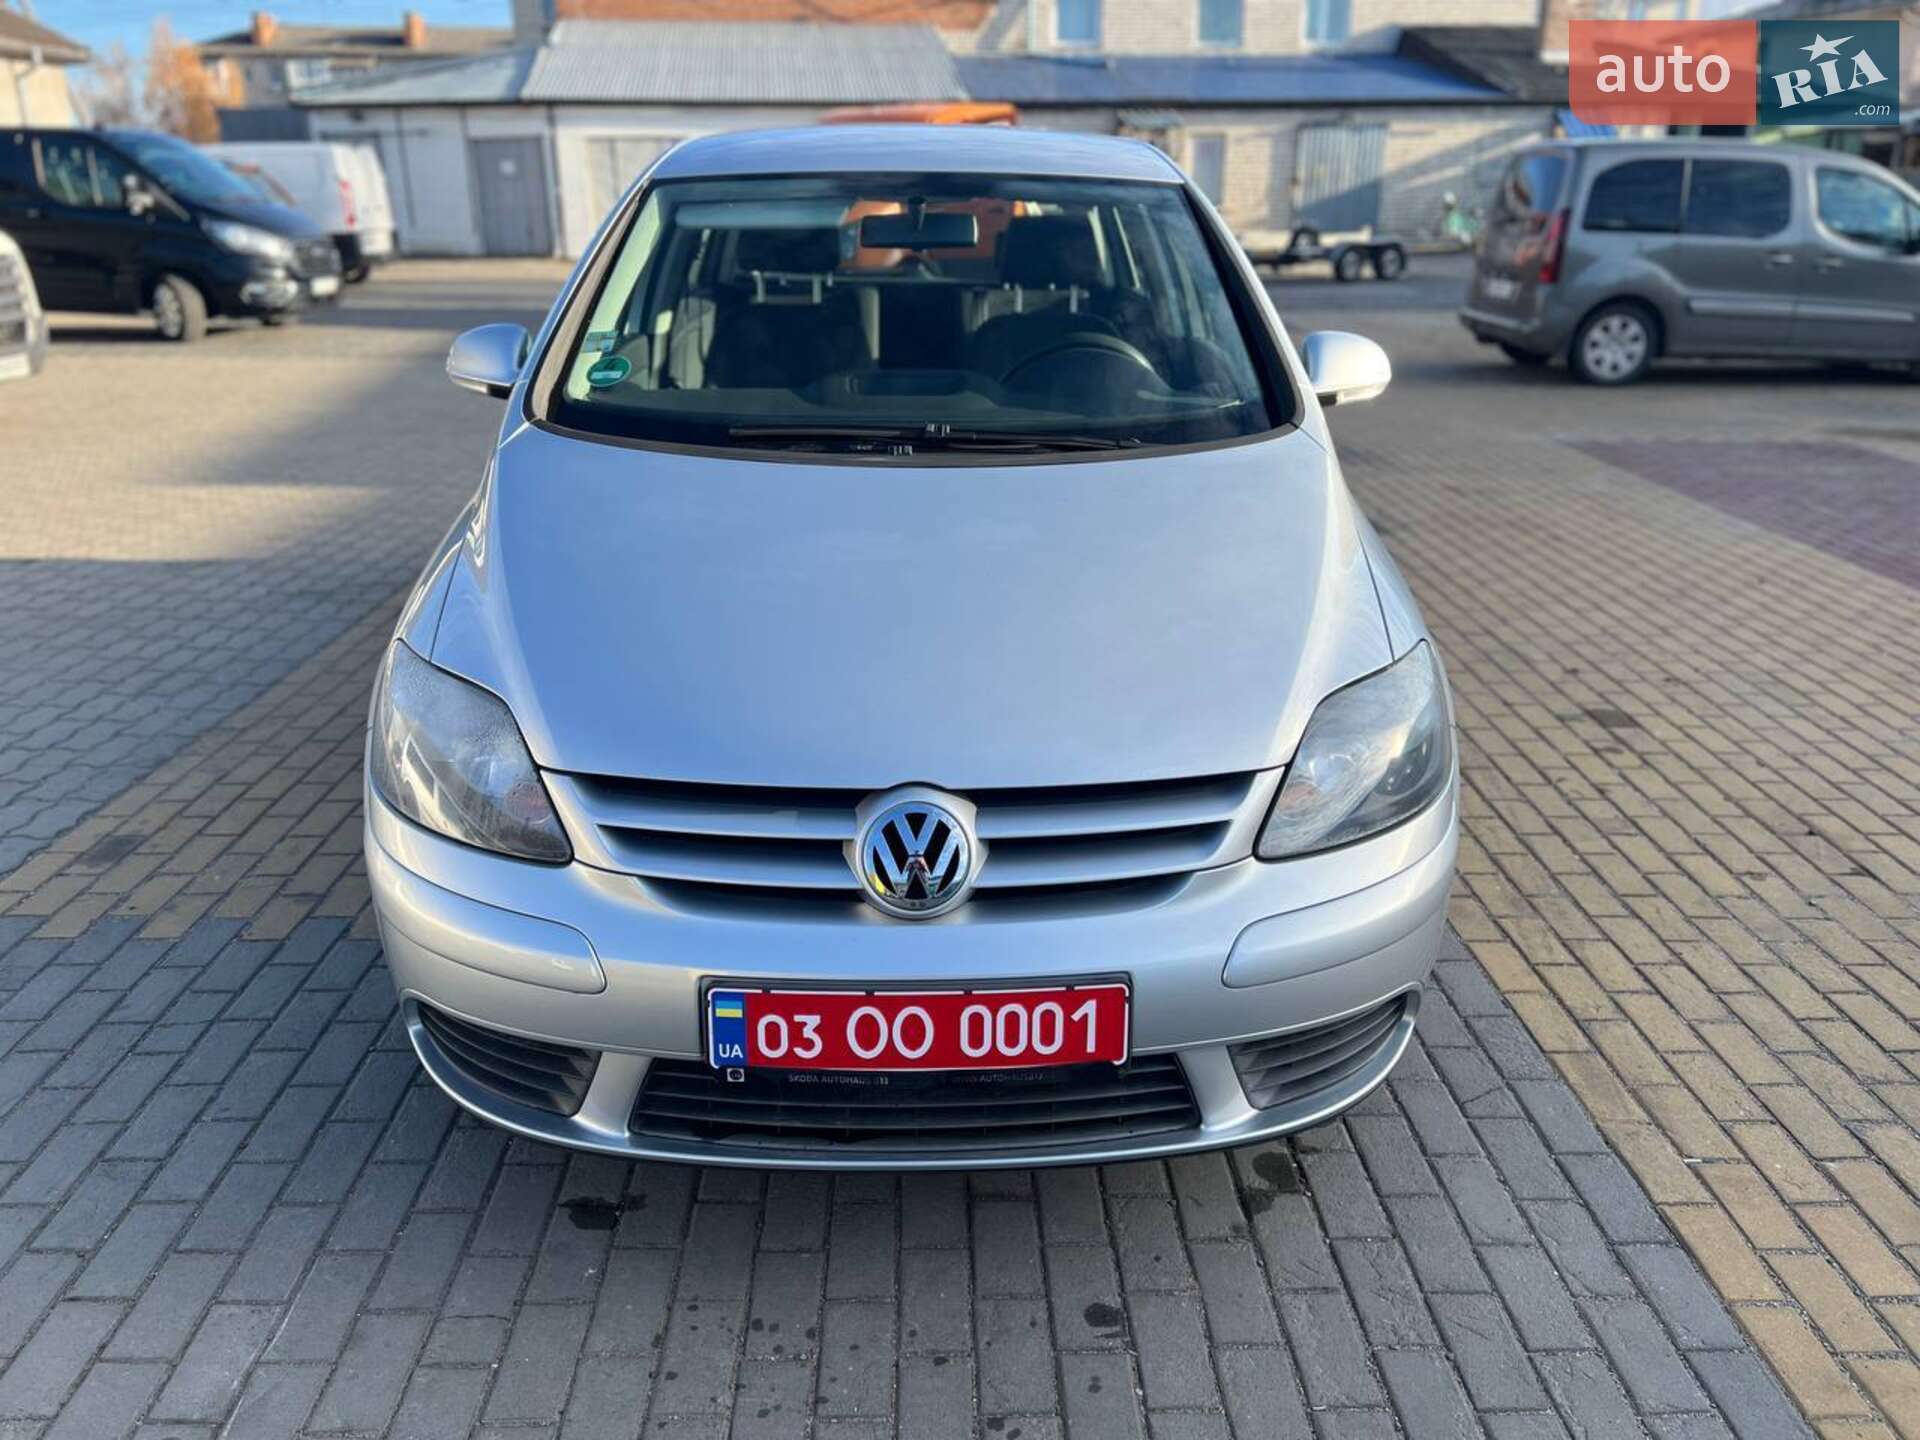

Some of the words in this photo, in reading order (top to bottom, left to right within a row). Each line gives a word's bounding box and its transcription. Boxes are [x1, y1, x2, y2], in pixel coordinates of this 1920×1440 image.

[757, 1014, 824, 1059] 03
[959, 999, 1098, 1058] 0001
[719, 1044, 743, 1059] UA
